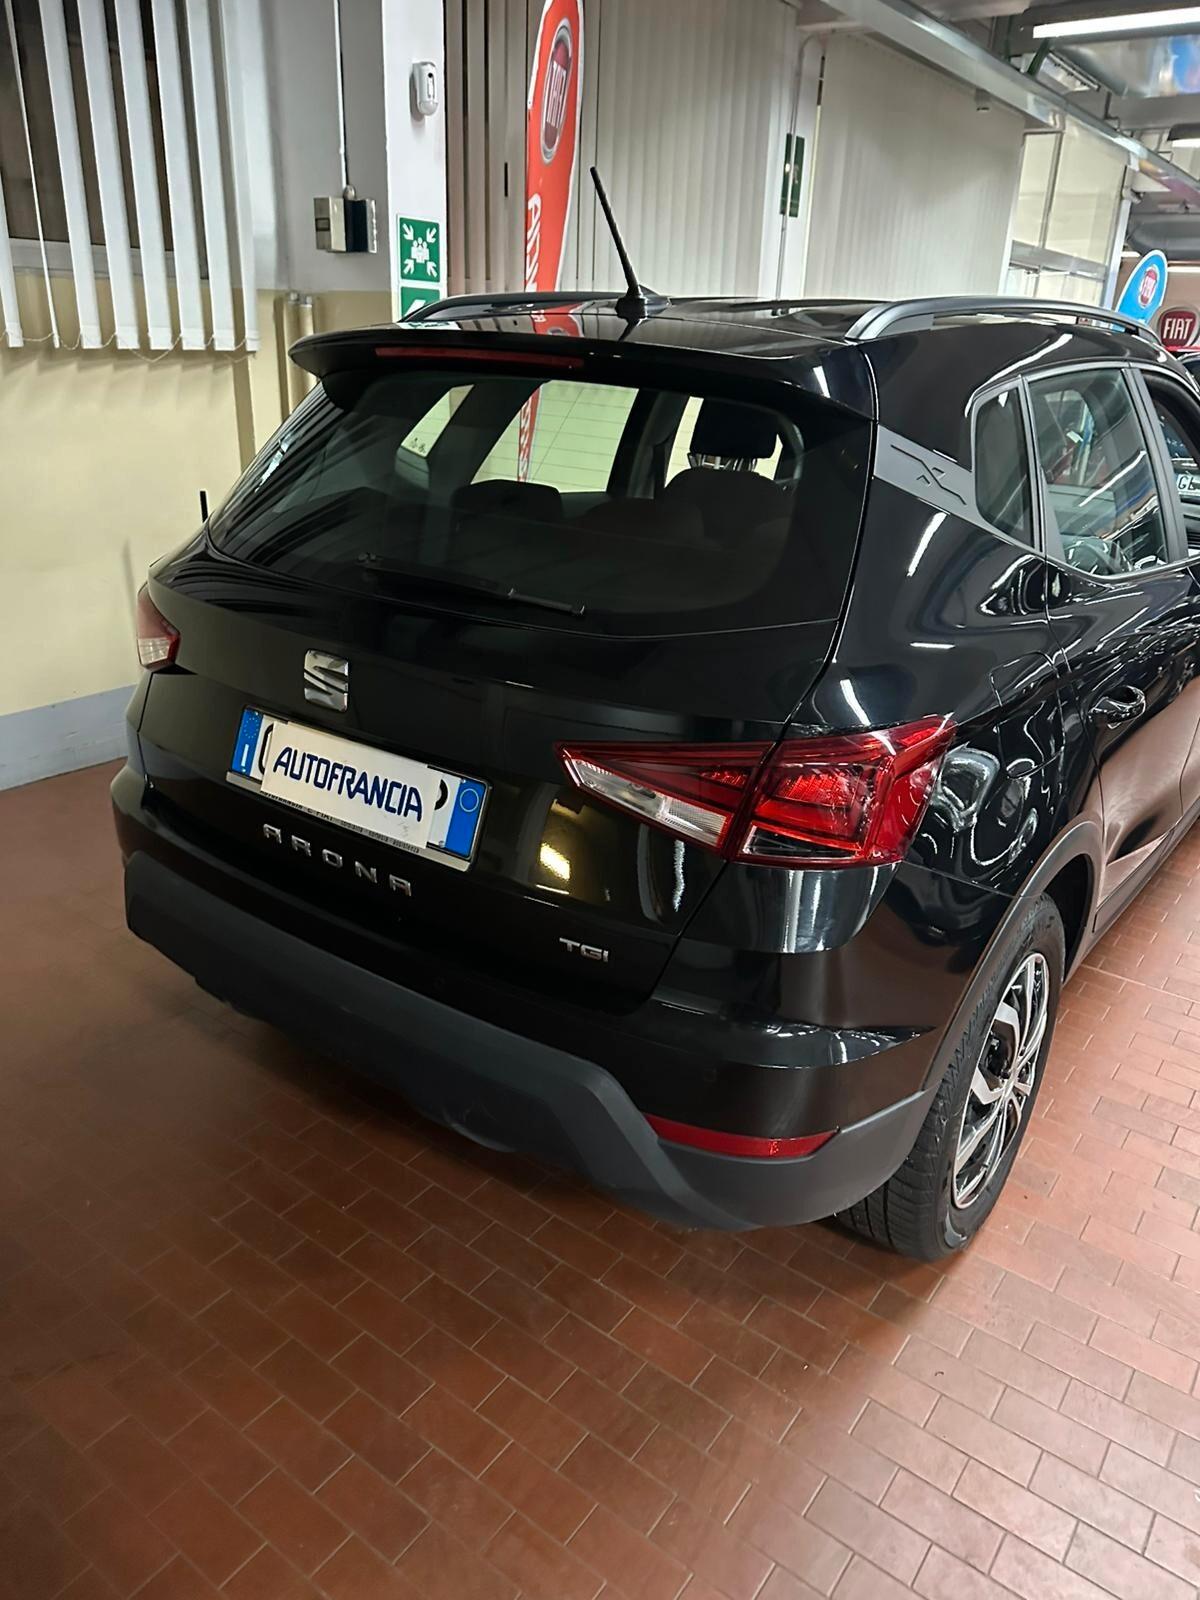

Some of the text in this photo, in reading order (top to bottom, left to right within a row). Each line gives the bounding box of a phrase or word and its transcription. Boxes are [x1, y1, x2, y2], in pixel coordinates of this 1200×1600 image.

[1162, 318, 1193, 340] FIAT
[272, 746, 423, 822] AUTOFRANCIA
[262, 823, 412, 897] ARONA
[559, 937, 609, 962] TGI
